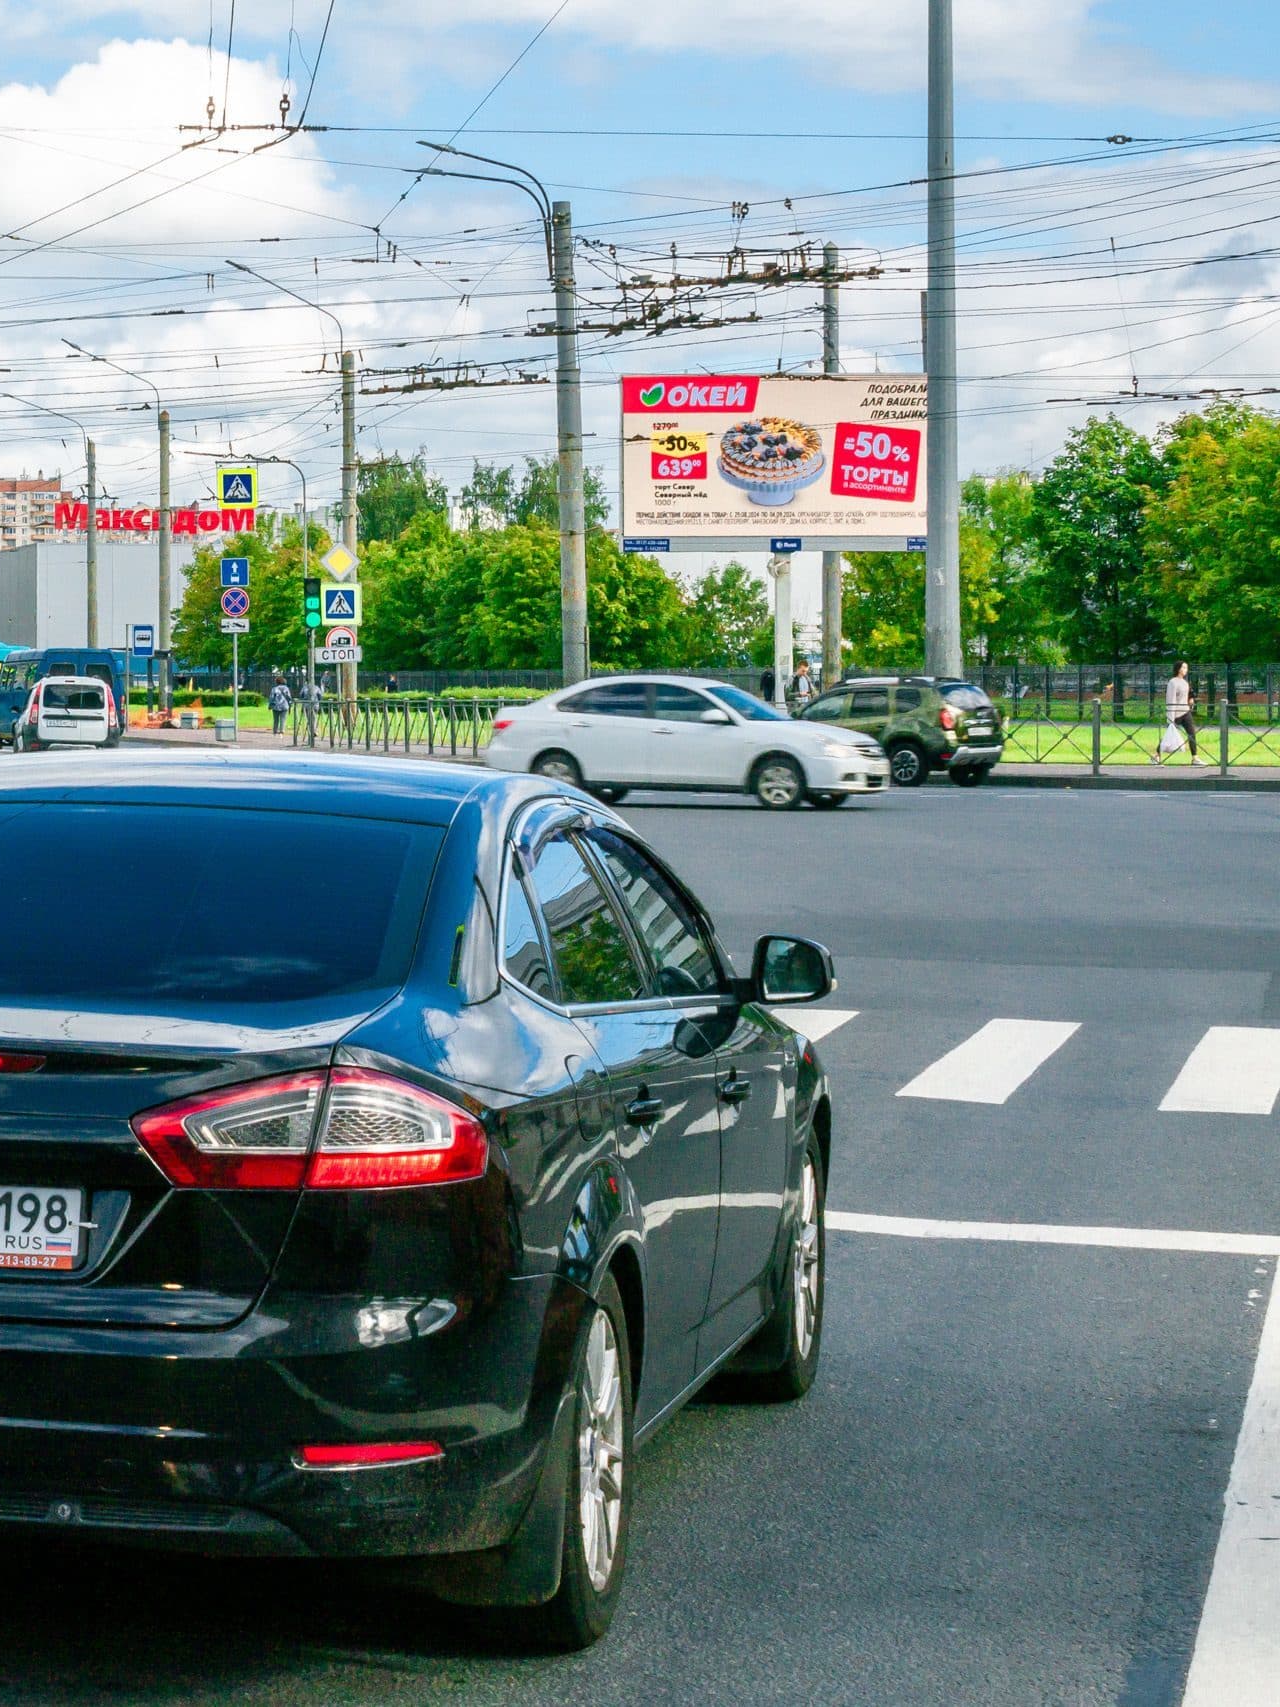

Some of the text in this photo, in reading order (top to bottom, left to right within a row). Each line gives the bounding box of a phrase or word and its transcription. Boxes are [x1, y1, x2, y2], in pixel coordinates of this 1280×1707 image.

[860, 397, 883, 407] ДЛЯ
[841, 465, 909, 487] ТОРТЫ
[321, 649, 355, 660] СТОП
[5, 1235, 41, 1250] RUS
